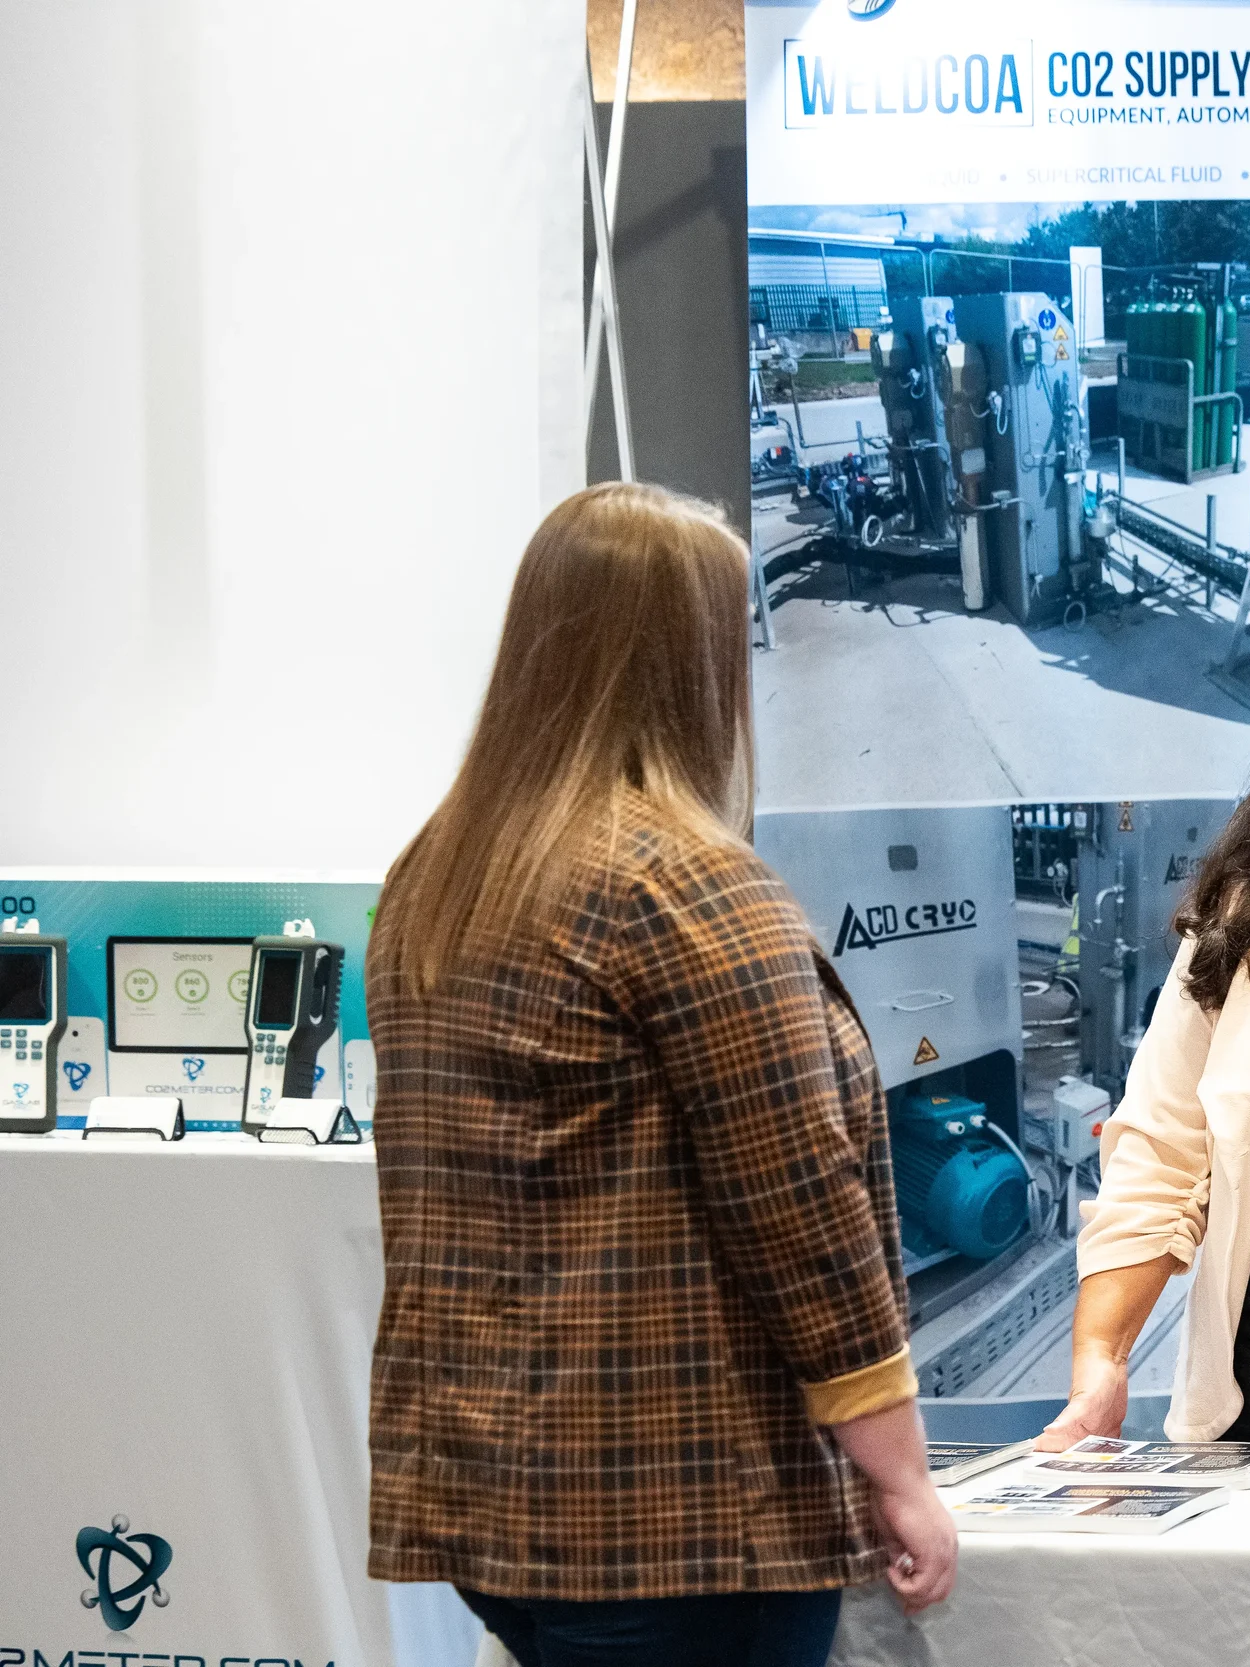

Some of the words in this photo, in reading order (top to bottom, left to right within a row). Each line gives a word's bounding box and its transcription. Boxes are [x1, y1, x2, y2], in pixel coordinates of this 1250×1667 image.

[796, 53, 1024, 116] WELDCOA
[1048, 51, 1114, 98] CO2
[1048, 107, 1171, 127] EQUIPMENT,
[1026, 166, 1166, 184] SUPERCRITICAL
[1171, 166, 1223, 183] FLUID
[832, 902, 898, 957] ACD
[905, 899, 977, 931] CRYO
[172, 951, 214, 963] Sensors
